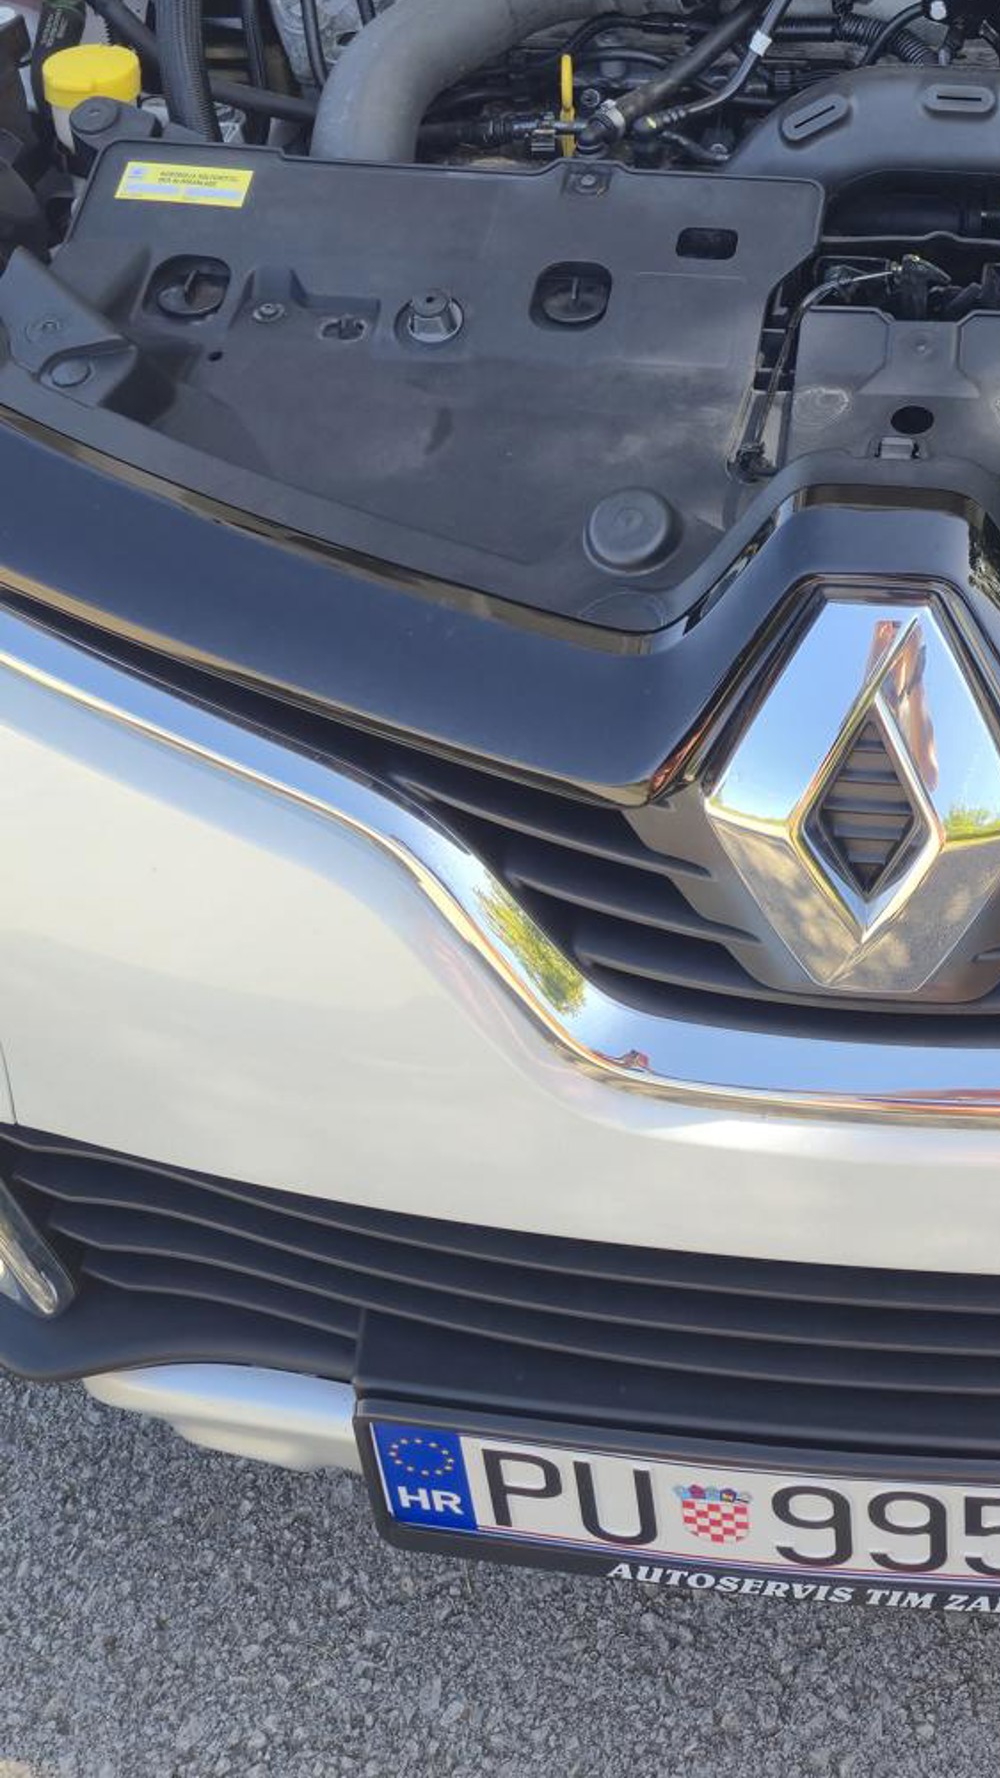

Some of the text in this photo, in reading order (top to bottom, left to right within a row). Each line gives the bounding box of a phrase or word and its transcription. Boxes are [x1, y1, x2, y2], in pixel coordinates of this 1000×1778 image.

[398, 1486, 464, 1515] HR
[482, 1448, 658, 1545] PU
[607, 1562, 854, 1602] AUTOSERVIS
[866, 1588, 937, 1609] TIM
